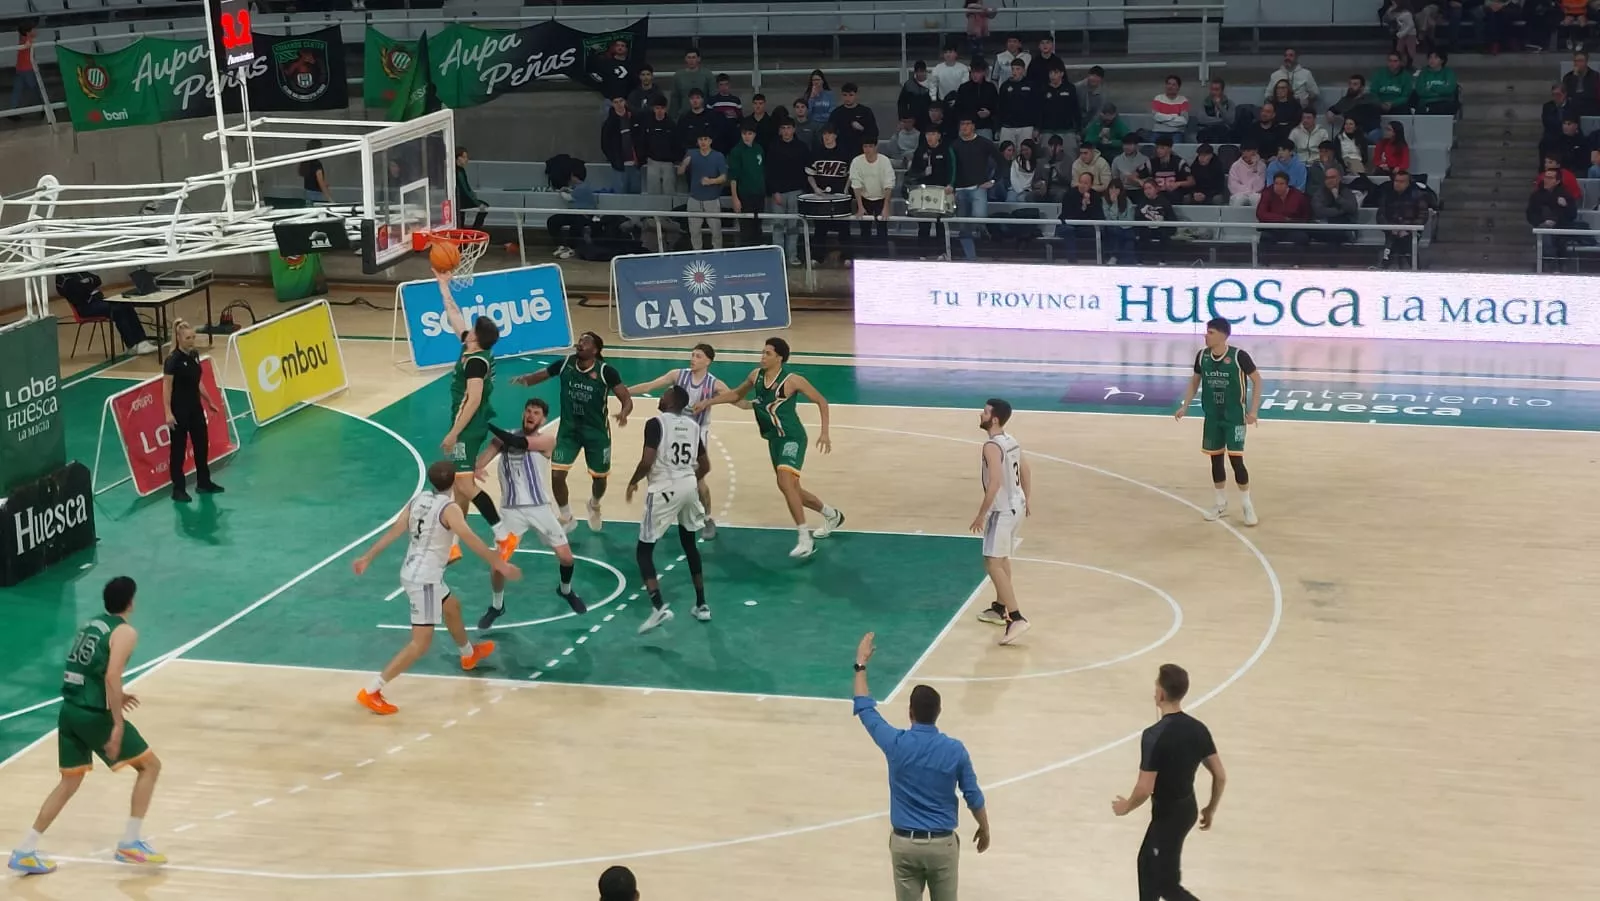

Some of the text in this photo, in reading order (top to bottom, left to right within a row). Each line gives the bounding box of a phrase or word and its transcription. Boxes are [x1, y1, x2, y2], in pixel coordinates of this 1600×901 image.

[132, 44, 210, 92] Aupa
[439, 33, 521, 76] Aupa
[480, 48, 576, 94] Peñas
[635, 292, 771, 330] GASBY
[257, 340, 328, 392] embou
[5, 375, 57, 408] Lobe
[1260, 398, 1462, 417] Huesca
[671, 442, 692, 465] 35
[14, 494, 88, 556] Huesca
